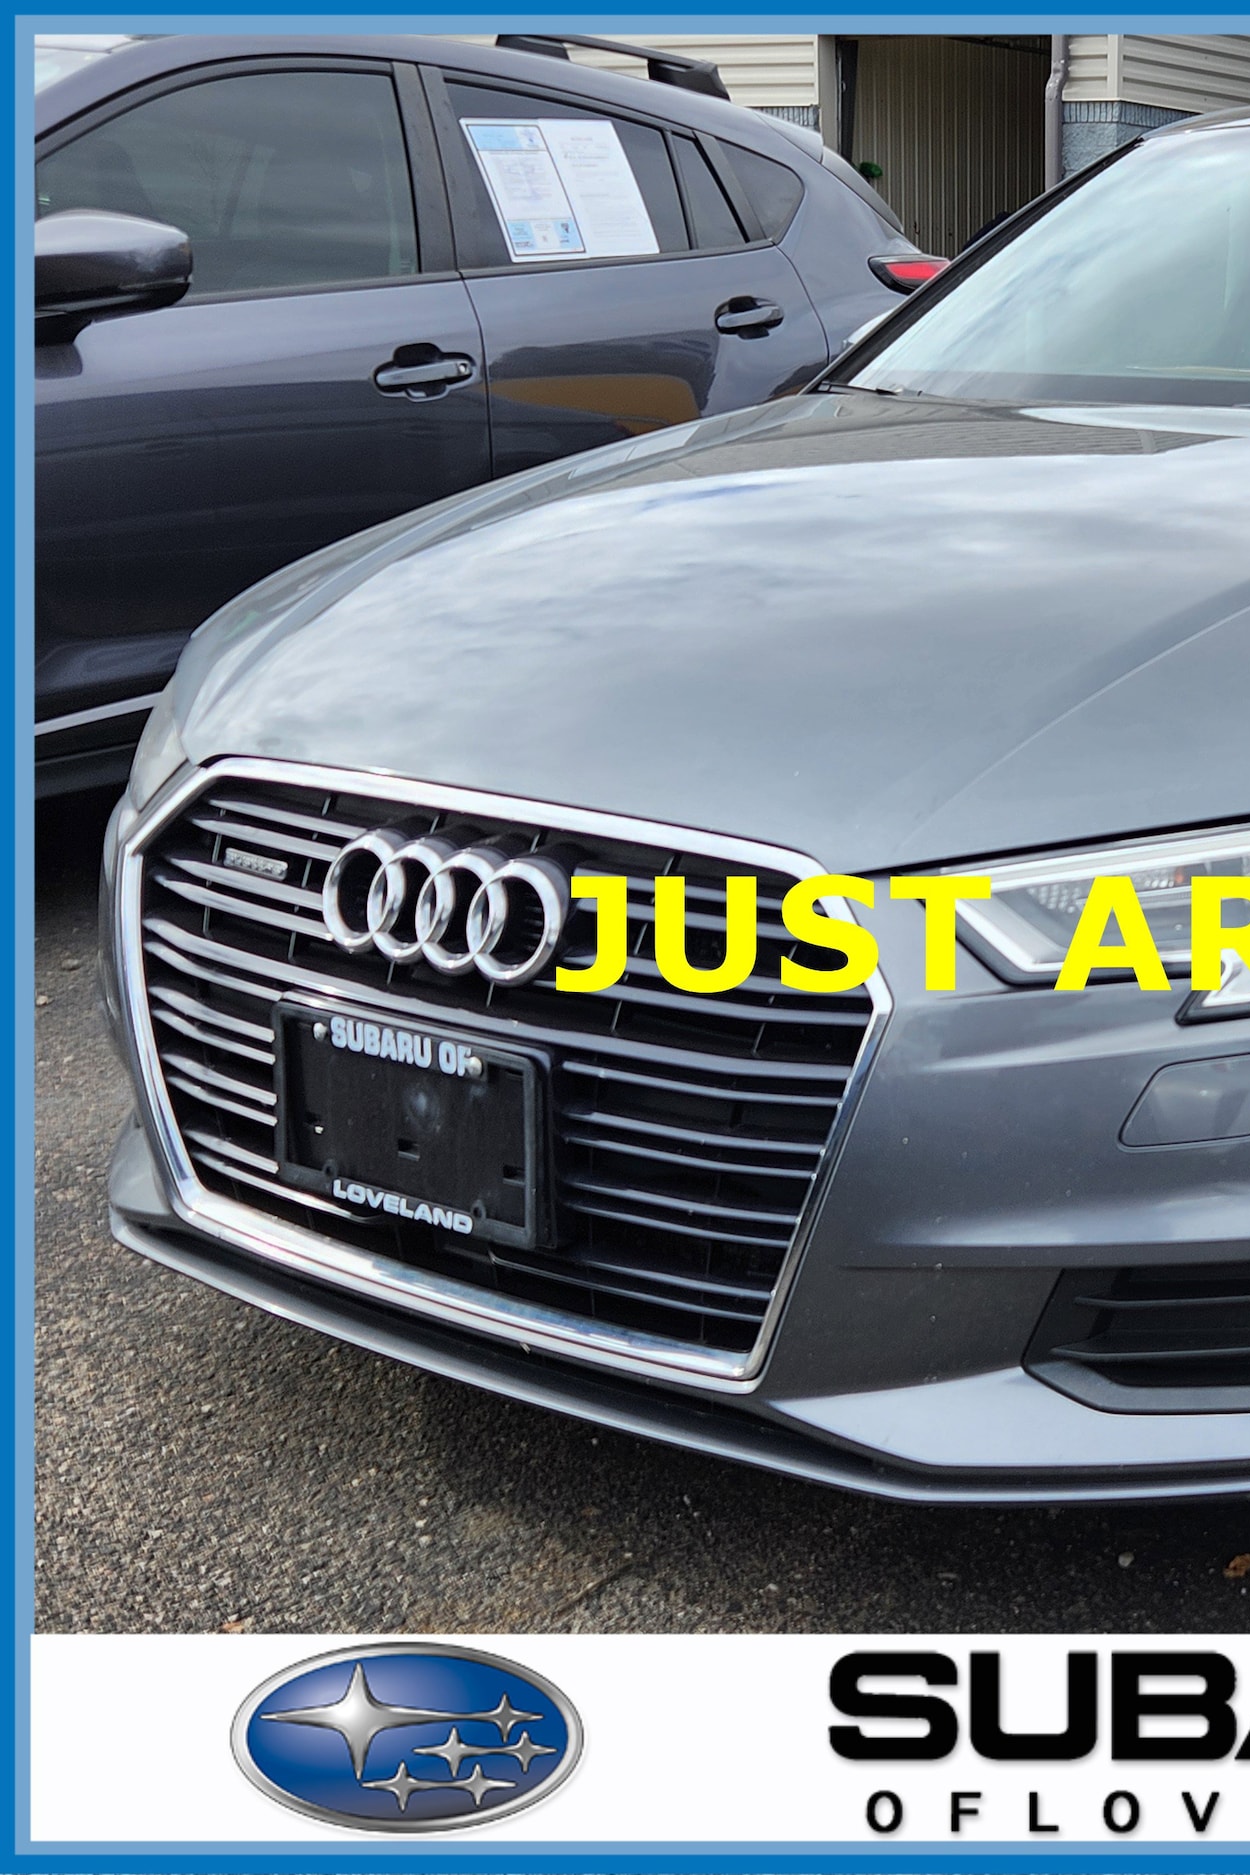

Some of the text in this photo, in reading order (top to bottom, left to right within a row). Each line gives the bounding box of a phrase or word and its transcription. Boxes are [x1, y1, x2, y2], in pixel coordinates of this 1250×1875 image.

[330, 1016, 472, 1077] SUBARU OF
[333, 1179, 473, 1235] LOVELAND
